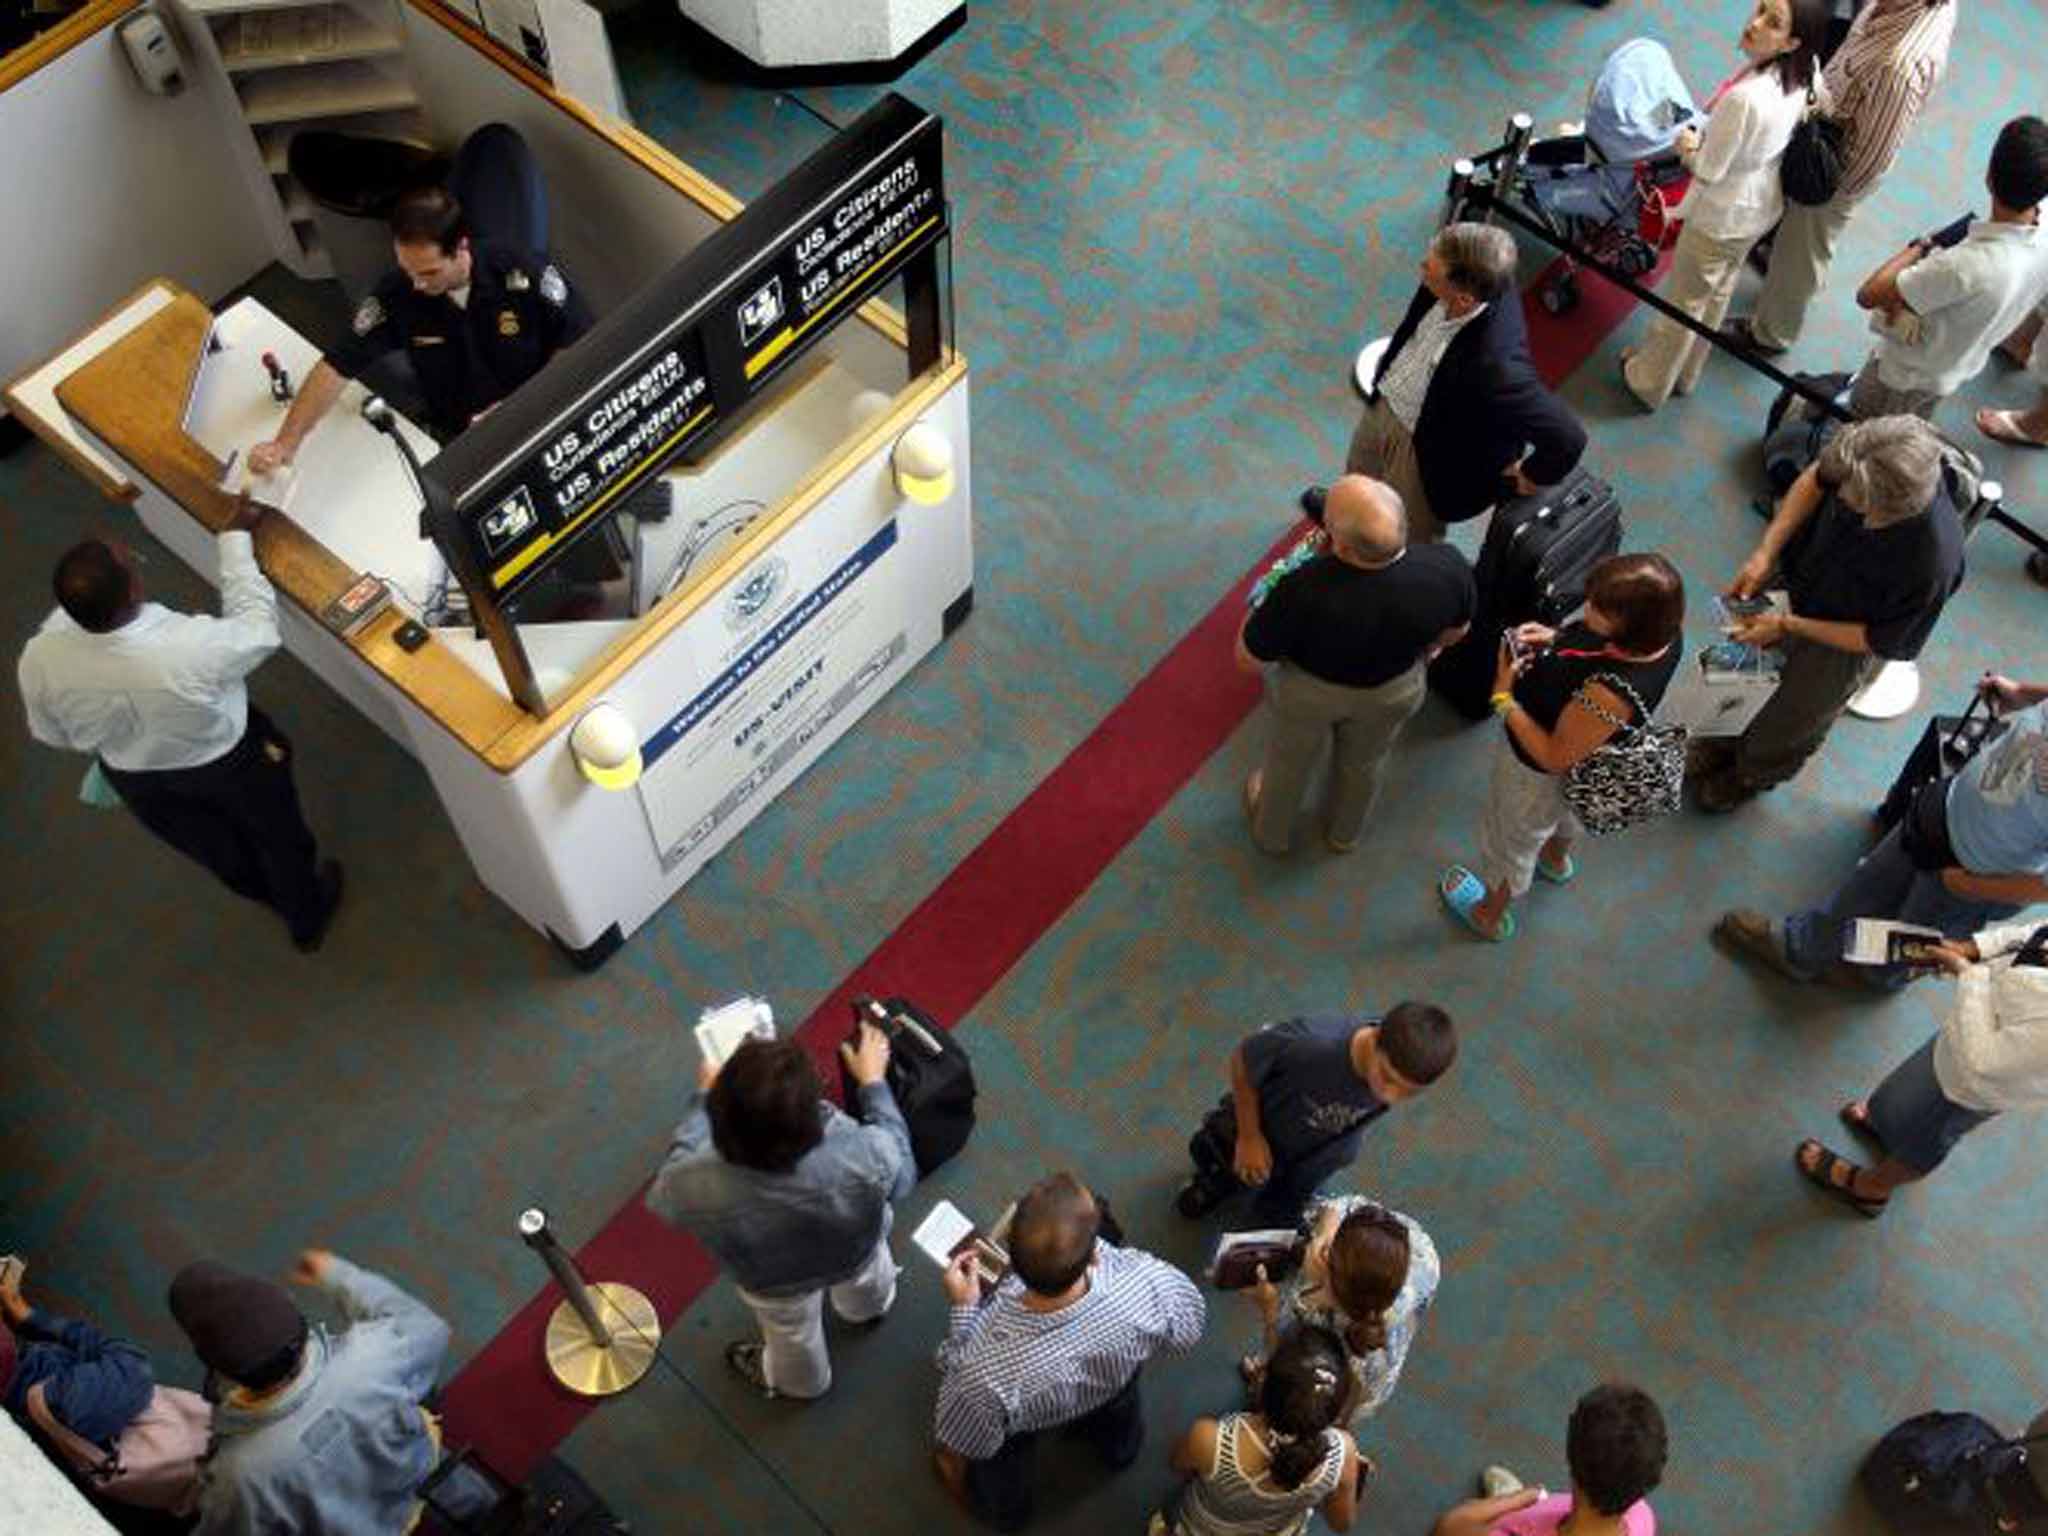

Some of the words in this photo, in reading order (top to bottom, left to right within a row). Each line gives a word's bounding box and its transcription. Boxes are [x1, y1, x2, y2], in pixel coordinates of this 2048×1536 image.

[796, 227, 826, 260] US
[833, 157, 915, 229] Citizens
[801, 268, 830, 301] US
[836, 187, 932, 273] Residents
[544, 432, 580, 467] US
[588, 351, 679, 431] Citizens
[557, 472, 592, 506] US
[598, 377, 706, 474] Residents
